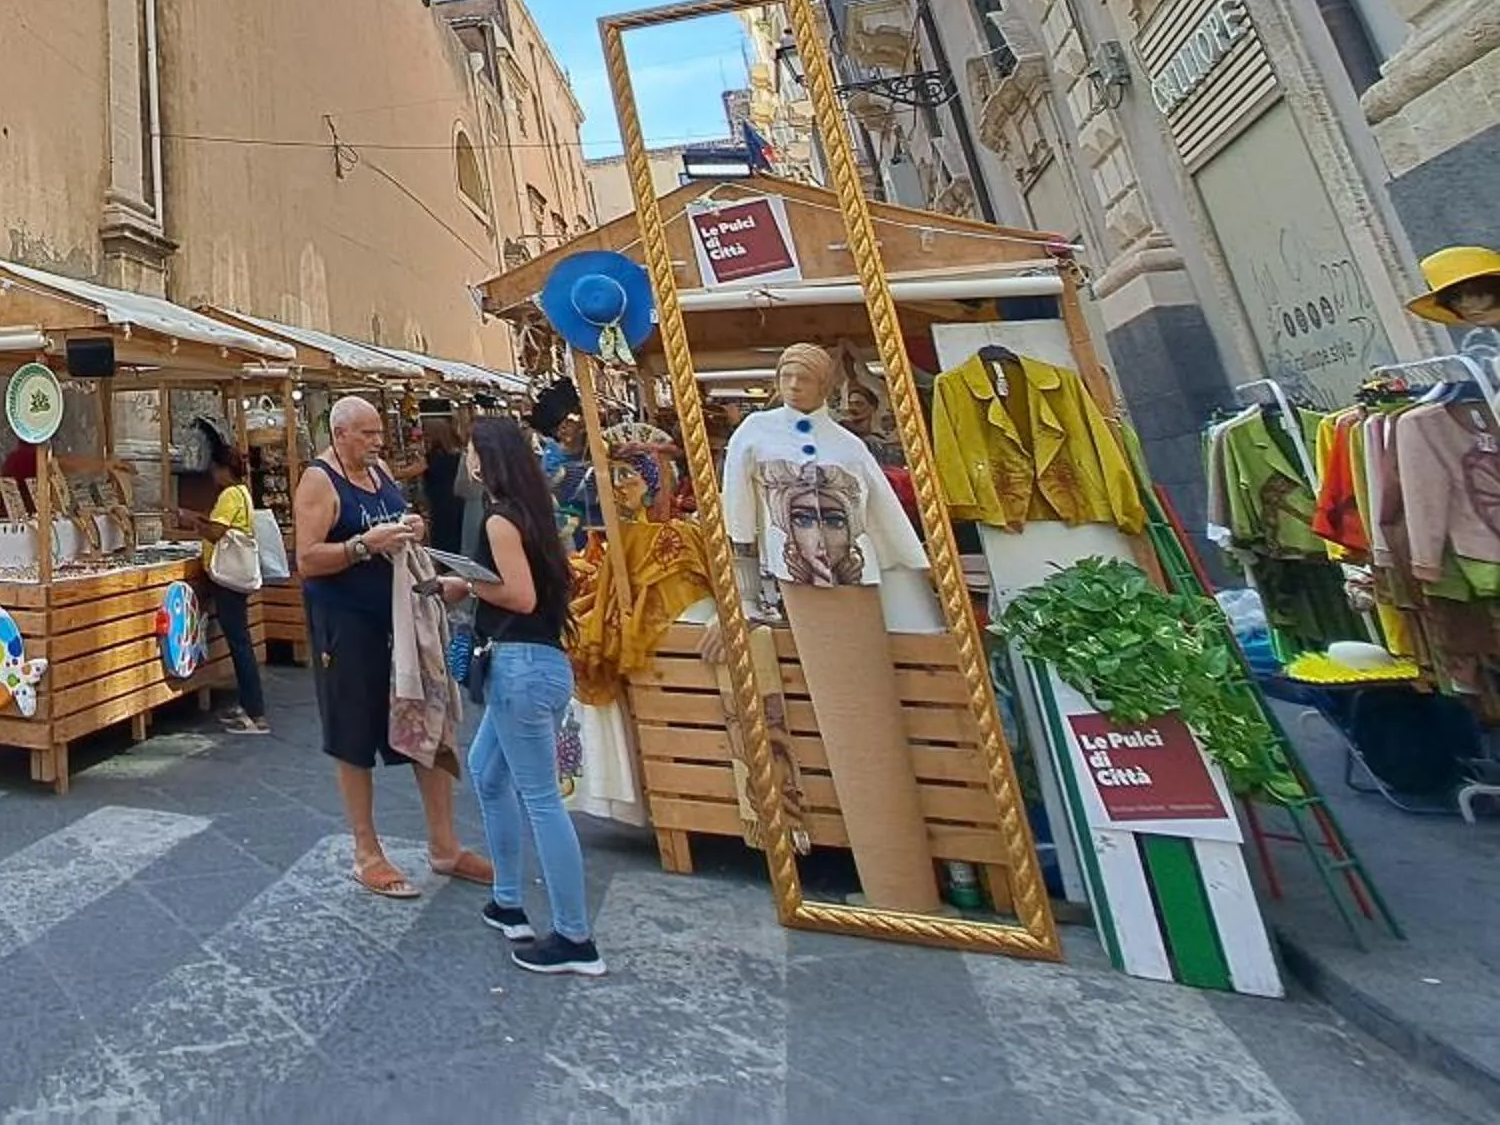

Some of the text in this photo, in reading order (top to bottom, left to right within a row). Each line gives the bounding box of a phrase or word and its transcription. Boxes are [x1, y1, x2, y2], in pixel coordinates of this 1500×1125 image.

[701, 215, 757, 238] Le Pulci
[706, 236, 721, 249] di
[710, 242, 748, 261] Città
[1079, 728, 1165, 750] Le Pulci
[1089, 750, 1113, 769] di
[1096, 766, 1153, 787] Città
